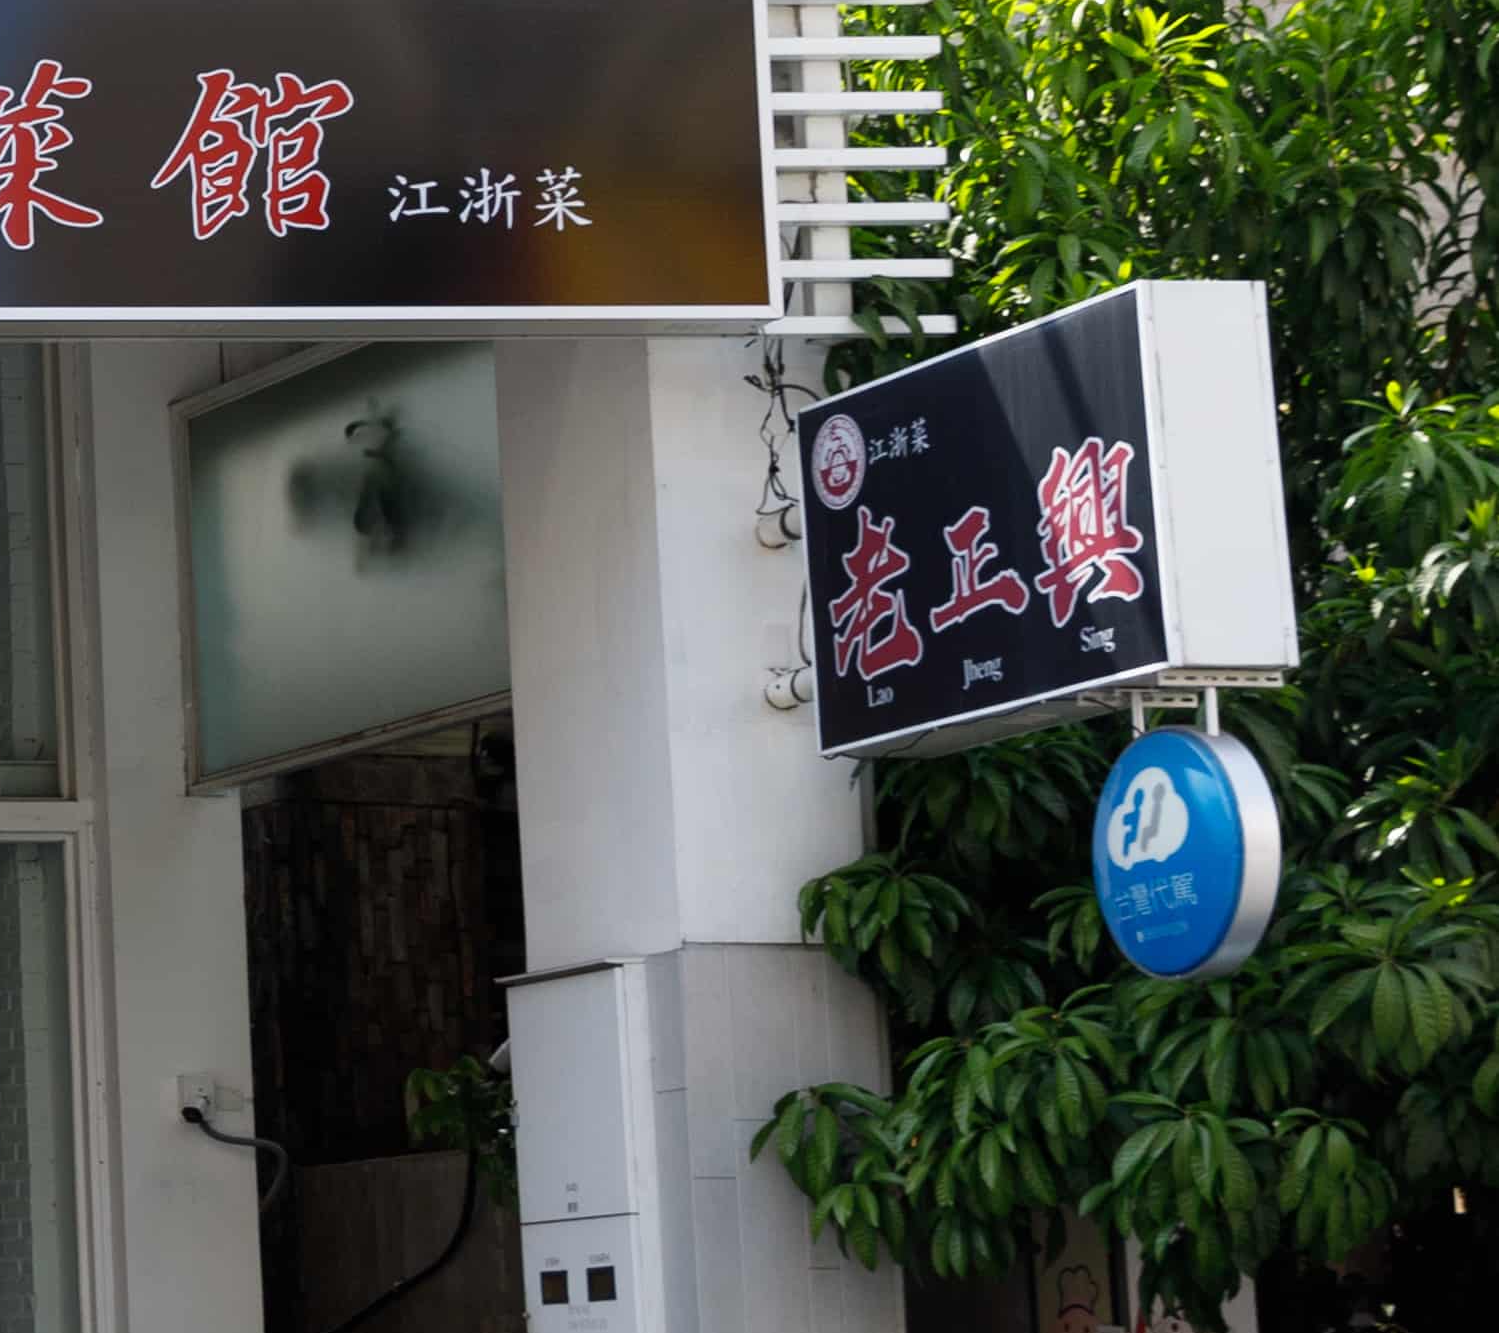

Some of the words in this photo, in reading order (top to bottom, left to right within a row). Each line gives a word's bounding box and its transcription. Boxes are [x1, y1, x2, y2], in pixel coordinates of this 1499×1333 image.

[385, 165, 595, 233] 江浙菜
[867, 416, 932, 465] 江浙菜
[827, 436, 1145, 681] 老正興
[1079, 624, 1116, 654] Sing
[962, 654, 1003, 690] Jheng
[866, 685, 894, 710] Lao
